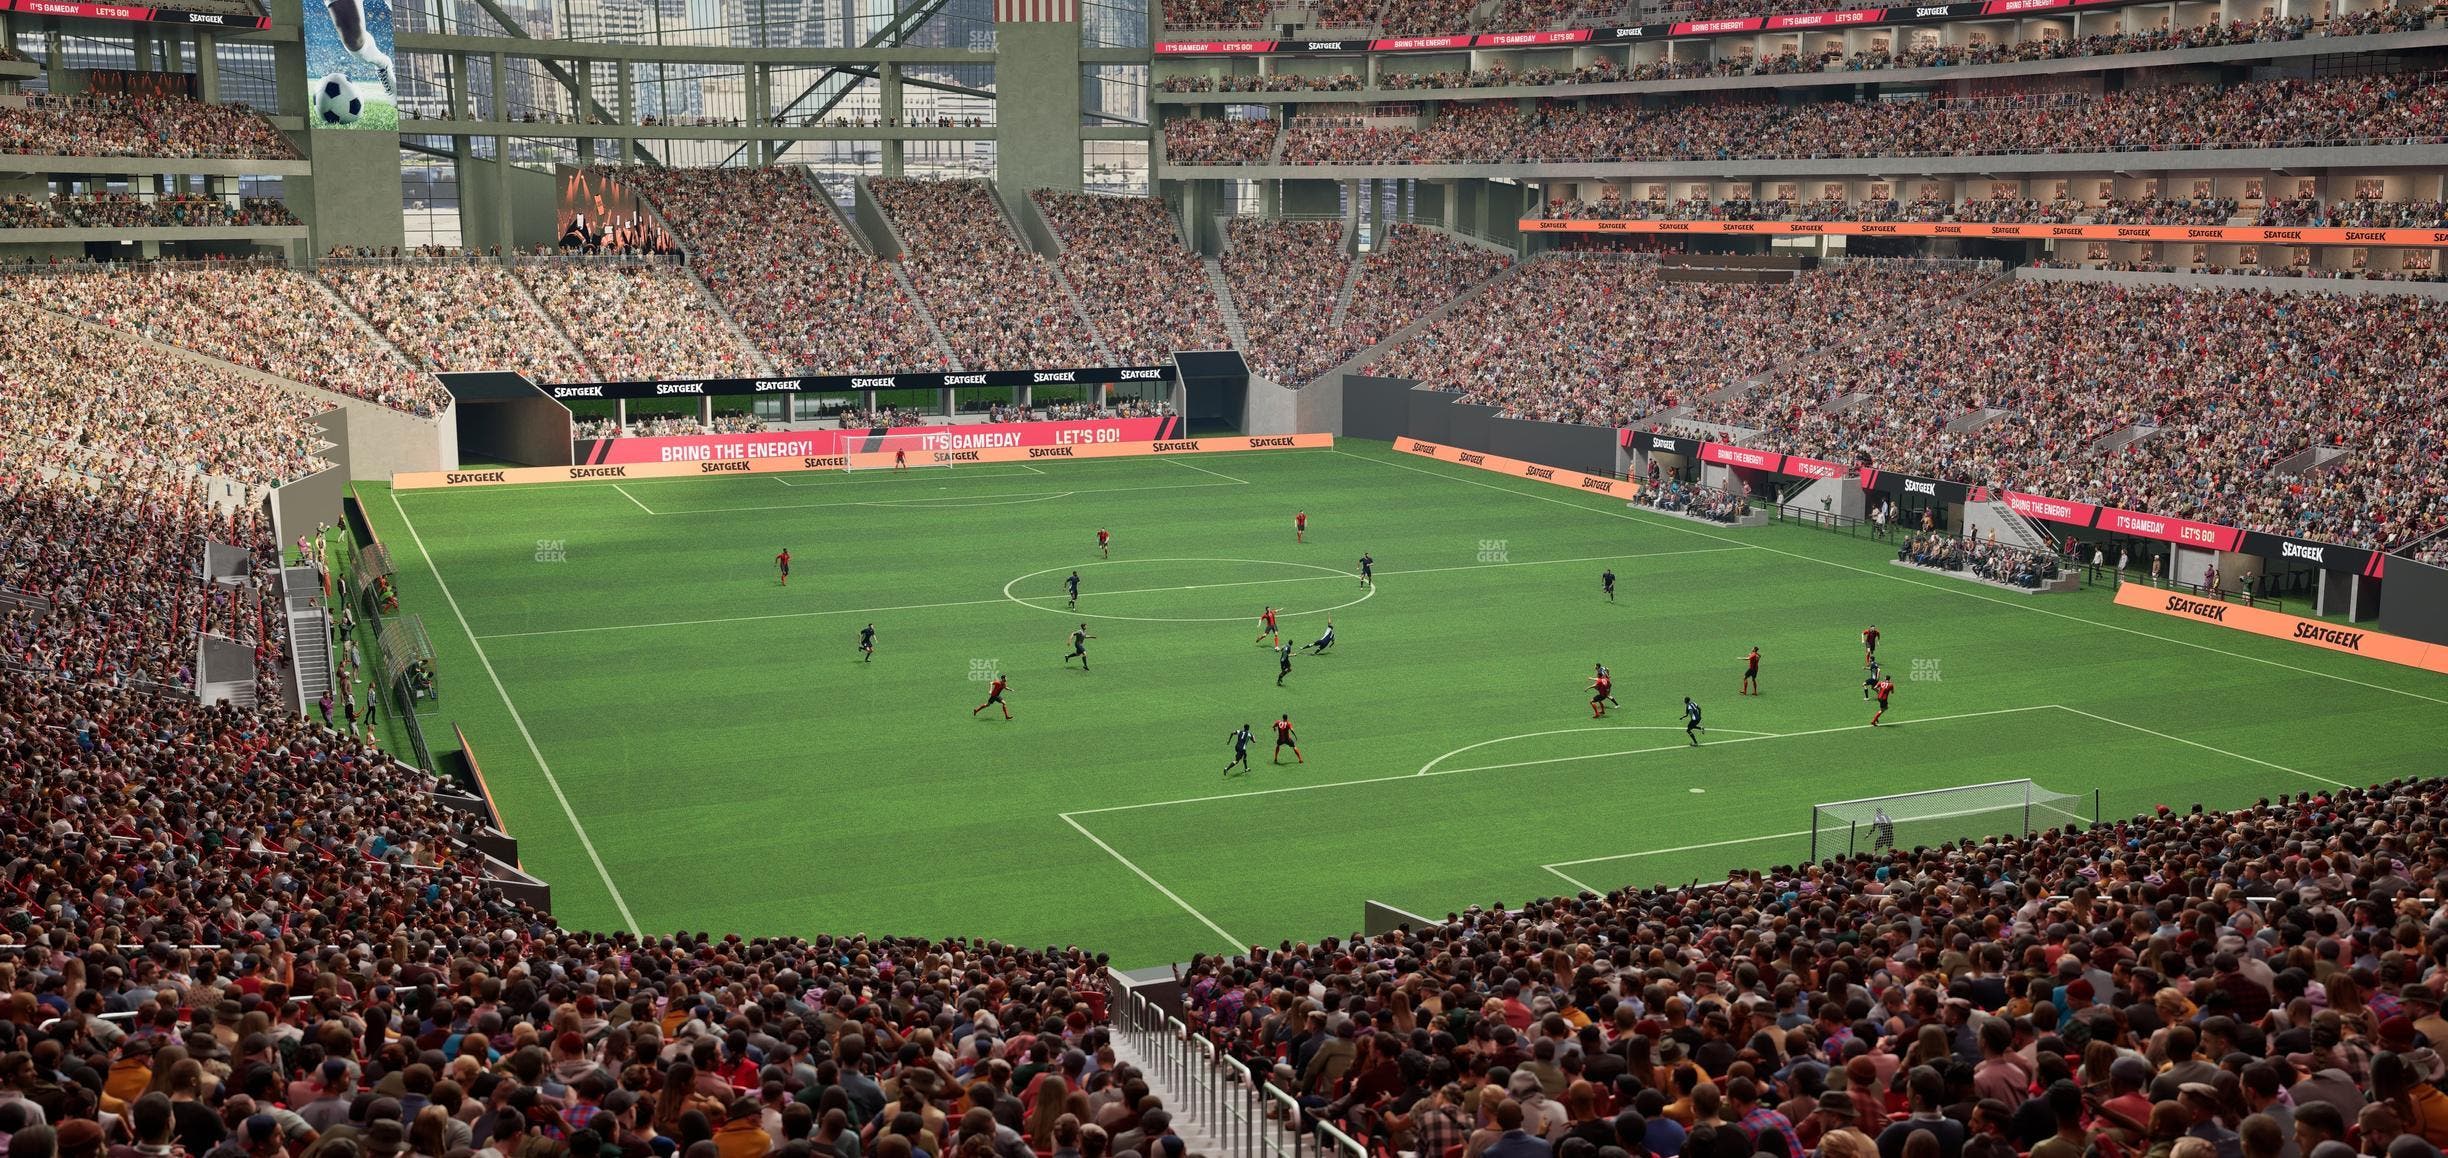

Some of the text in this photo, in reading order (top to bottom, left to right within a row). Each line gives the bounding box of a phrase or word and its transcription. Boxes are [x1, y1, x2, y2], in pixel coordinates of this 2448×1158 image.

[44, 5, 79, 13] GAMEDAY
[116, 9, 129, 17] GO!
[1916, 6, 1948, 17] SEATGEEK
[189, 13, 223, 24] SEATGEEK
[1794, 16, 1822, 24] GAMEDAY
[1852, 13, 1863, 21] GO!
[1617, 28, 1642, 37] SEATGEEK
[1692, 22, 1744, 32] BRING THE ENERGY!
[1425, 39, 1451, 47] ENERGY!
[1506, 35, 1536, 43] GAMEDAY
[1179, 43, 1208, 51] GAMEDAY
[1308, 41, 1341, 50] SEATGEEK
[1659, 223, 1688, 231] SEATGEEK
[1790, 224, 1823, 232] SEATGEEK
[1861, 225, 1896, 233] SEATGEEK
[1934, 225, 1961, 234] SEATGEEK
[1991, 226, 2019, 234] SEATGEEK
[2053, 227, 2083, 235] SEATGEEK
[2118, 228, 2150, 237] SEATGEEK
[2188, 229, 2223, 238] SEATGEEK
[2263, 230, 2301, 240] SEATGEEK
[2345, 231, 2386, 241] SEATGEEK
[944, 374, 987, 385] SEATGEEK
[1034, 371, 1075, 382] SEATGEEK
[1121, 369, 1161, 379] SEATGEEK
[755, 380, 800, 391] SEATGEEK
[851, 377, 895, 388] SEATGEEK
[554, 386, 602, 398] SEATGEEK
[657, 383, 703, 394] SEATGEEK
[922, 428, 1120, 450] IT'S GAMEDAY LET'S GO!
[1249, 436, 1295, 449] SEATGEEK
[1653, 437, 1676, 452] SEATGEEK
[661, 441, 812, 462] BRING THE ENERGY!
[1153, 440, 1199, 453] SEATGEEK
[1412, 442, 1437, 456] SEATGEEK
[934, 451, 979, 462] SEATGEEK
[1029, 447, 1073, 458] SEATGEEK
[1718, 449, 1732, 460] BRING
[1733, 451, 1742, 461] THE
[1459, 452, 1485, 465] SEATGEEK
[570, 466, 625, 479] SEATGEEK
[701, 461, 750, 473] SEATGEEK
[1526, 465, 1554, 480] SEATGEEK
[447, 471, 504, 485] SEATGEEK
[1582, 477, 1613, 493] SEATGEEK
[1904, 479, 1936, 496] SEATGEEK
[2031, 502, 2042, 513] THE
[2044, 503, 2071, 519] ENERGY!
[2117, 516, 2215, 543] IT'S GAMEDAY LET'S GO!
[2281, 541, 2324, 563] SEATGEEK
[2165, 595, 2228, 622] SEATGEEK
[2293, 622, 2364, 651] SEATGEEK
